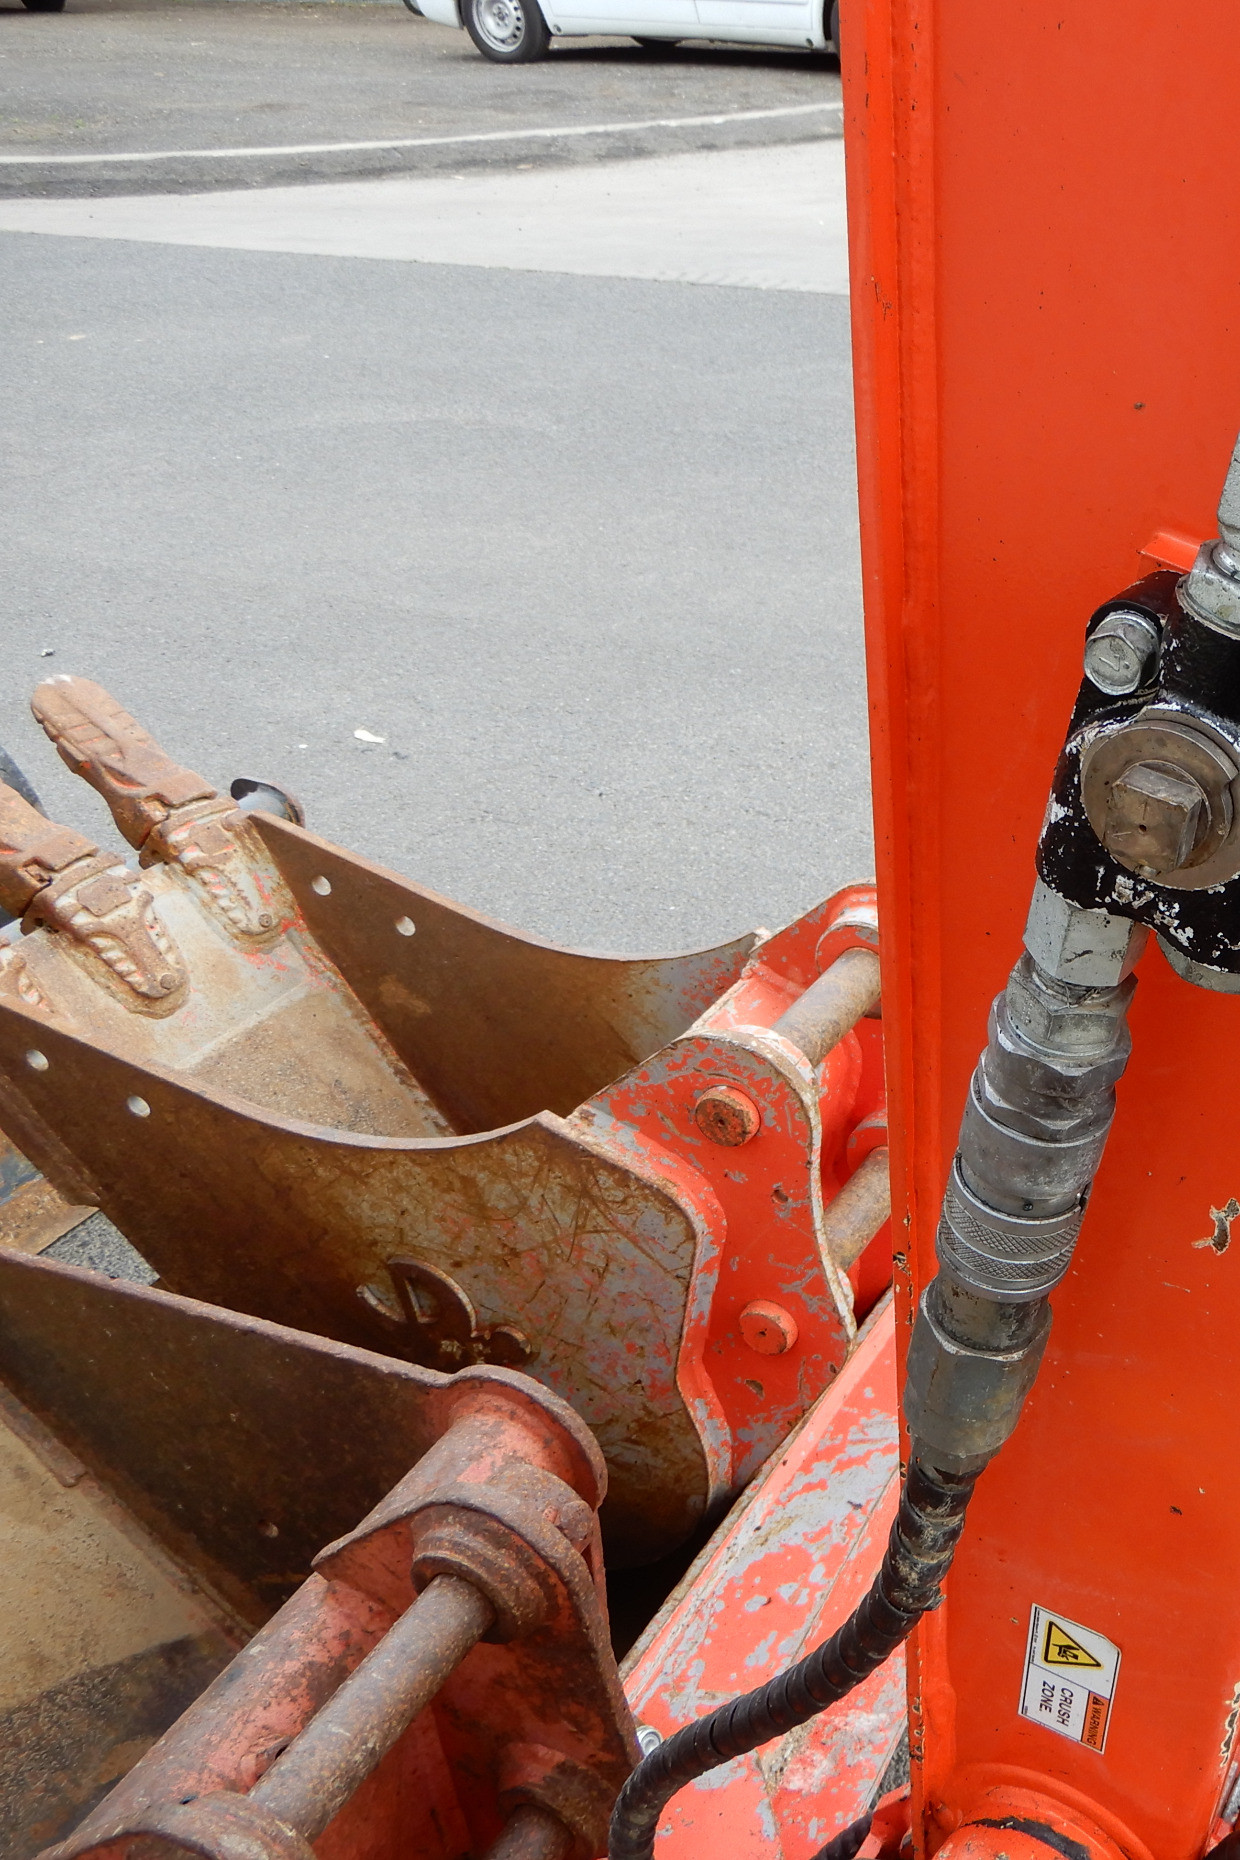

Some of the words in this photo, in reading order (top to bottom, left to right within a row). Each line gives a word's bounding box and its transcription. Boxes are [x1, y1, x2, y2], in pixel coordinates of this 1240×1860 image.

[1039, 1680, 1056, 1713] ZONE.
[1056, 1687, 1074, 1727] CRUSH
[1086, 1707, 1103, 1746] WARNING
